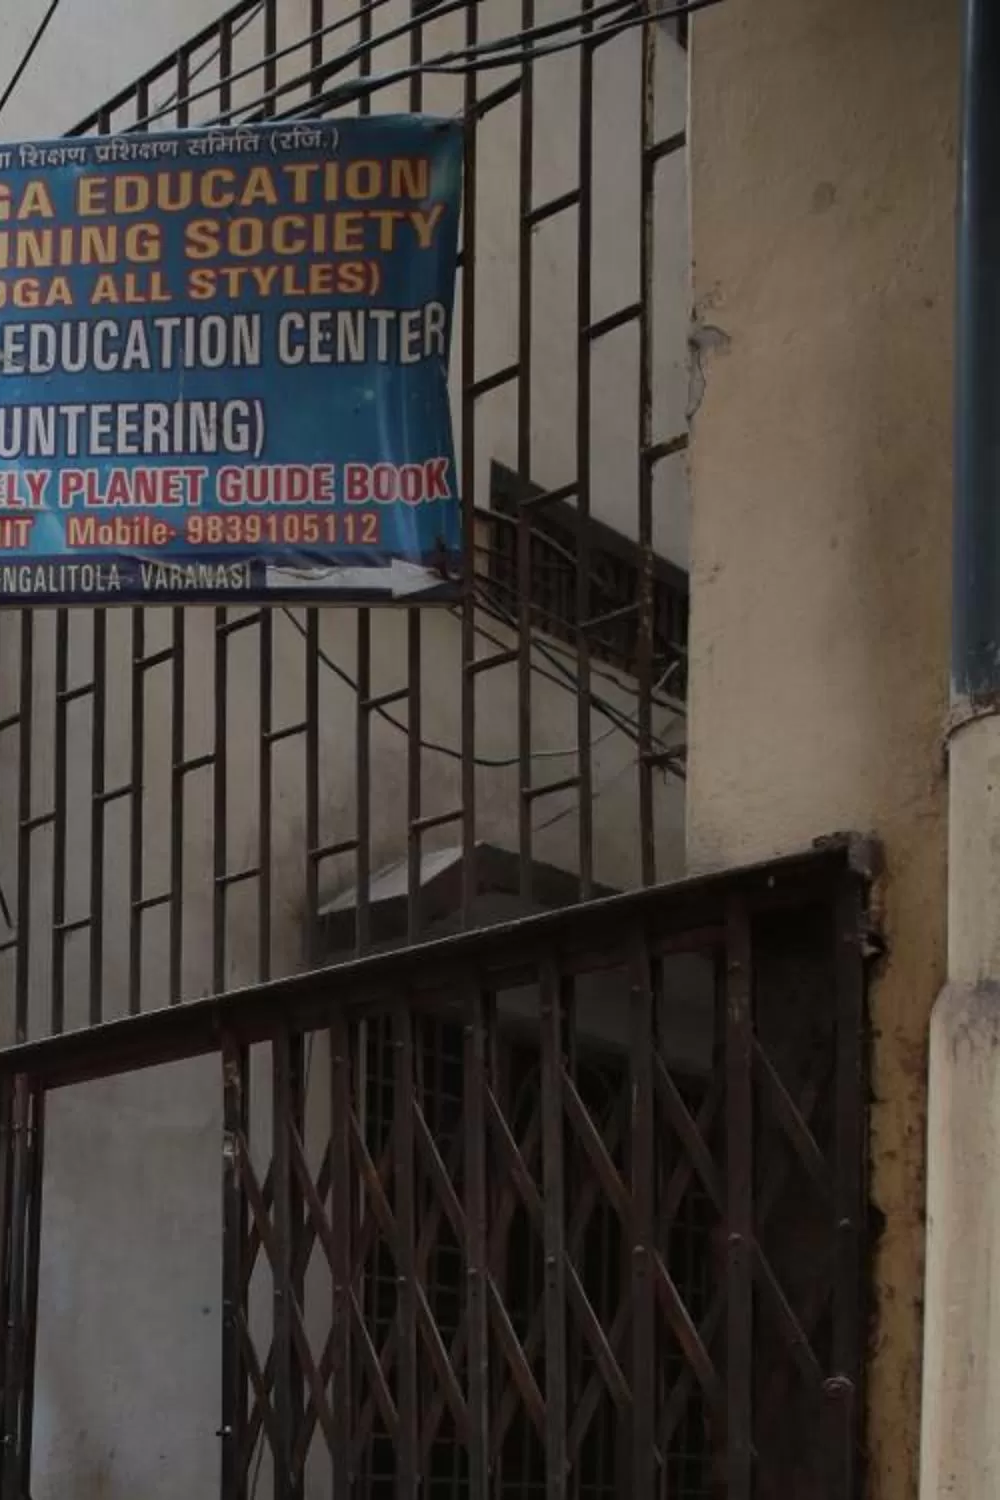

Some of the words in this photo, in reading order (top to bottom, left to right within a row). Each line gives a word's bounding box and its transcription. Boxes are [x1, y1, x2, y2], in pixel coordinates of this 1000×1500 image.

[187, 130, 260, 156] समिति
[77, 158, 429, 217] EDUCATION
[184, 204, 444, 260] SOCIETY
[90, 271, 173, 305] ALL
[188, 261, 381, 300] STYLES)
[3, 313, 261, 375] EDUCATION
[278, 302, 447, 364] CENTER
[58, 467, 209, 508] PLANET
[216, 463, 336, 506] GUIDE
[343, 457, 451, 504] BOOK
[186, 513, 378, 546] 9839105112
[139, 562, 251, 590] VARANASI
